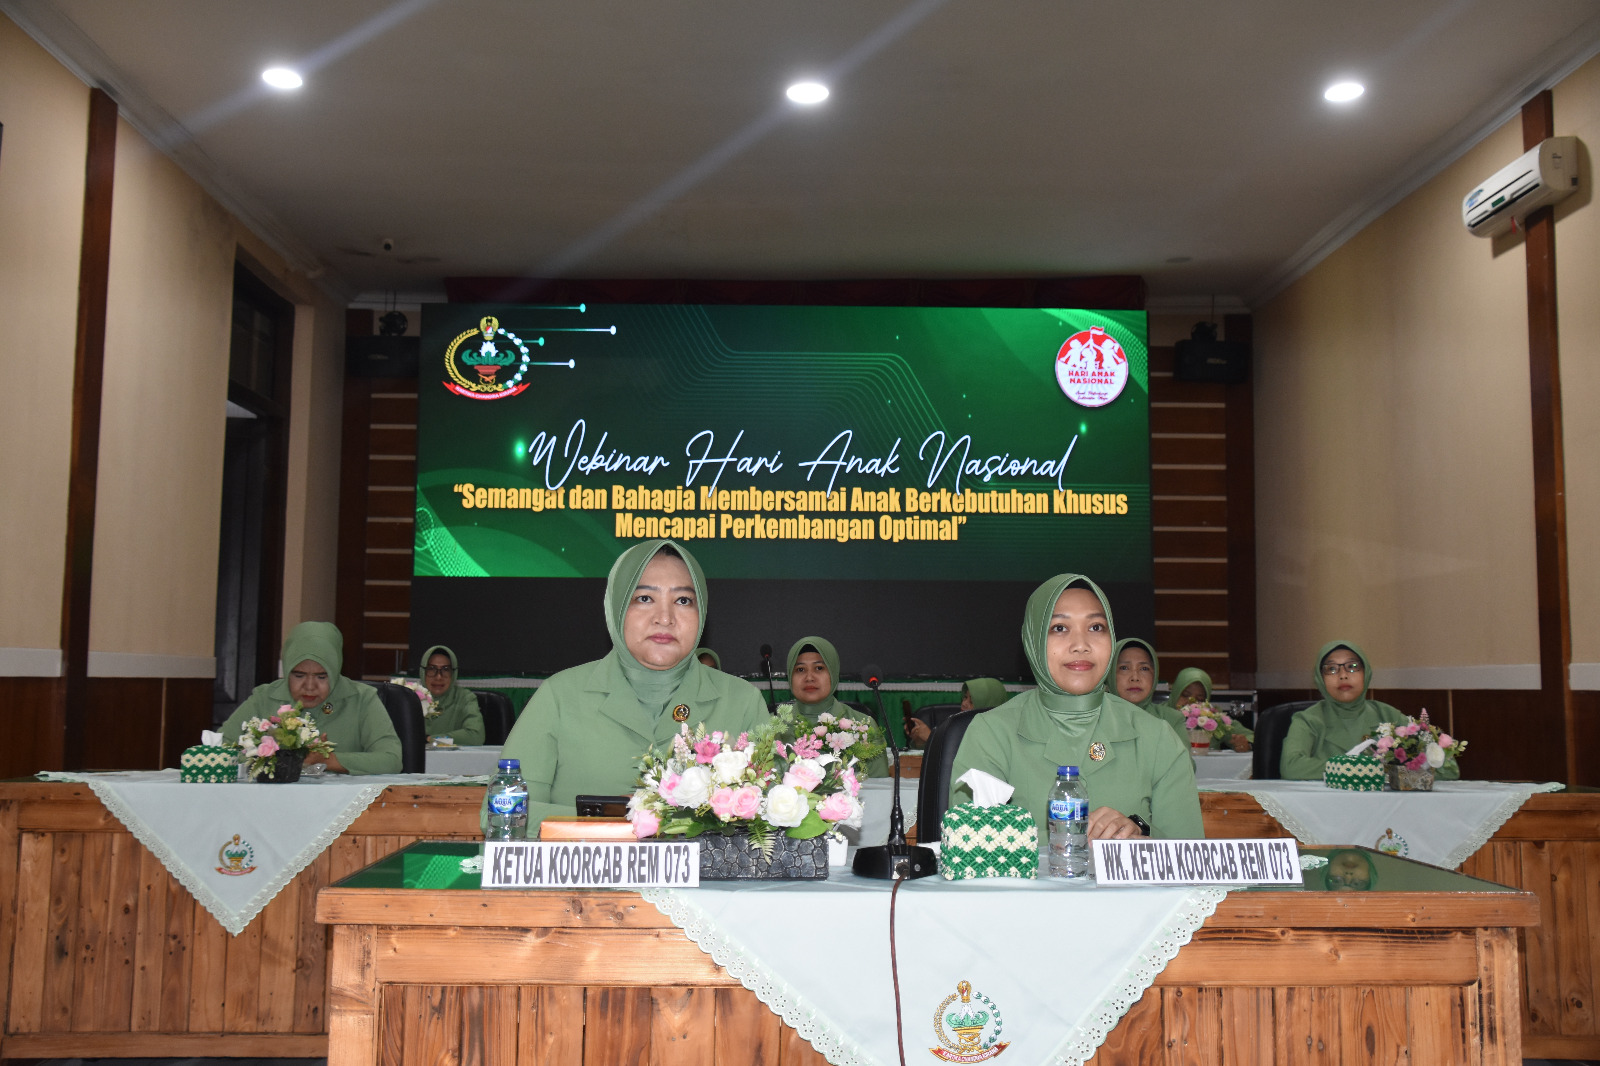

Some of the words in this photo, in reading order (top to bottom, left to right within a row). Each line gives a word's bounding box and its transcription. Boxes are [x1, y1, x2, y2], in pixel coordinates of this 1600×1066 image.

[528, 418, 670, 490] Webinar
[685, 429, 783, 498] Hari
[798, 429, 902, 498] Anak
[918, 431, 1078, 496] Nasional
[453, 483, 565, 512] “Semangat
[569, 485, 607, 510] dan
[611, 485, 696, 513] Bahagia
[700, 486, 847, 512] Membersamai
[850, 487, 901, 513] Anak
[905, 488, 1049, 514] Berkebutuhan
[1053, 489, 1128, 514] Khusus
[615, 513, 716, 541] Mencapai
[720, 514, 875, 542] Perkembangan
[879, 515, 967, 542] Optimal”
[494, 797, 512, 806] AQUA
[1051, 803, 1068, 812] AQUA
[491, 846, 543, 884] KETUA
[548, 845, 622, 884] KOORCAB
[627, 845, 659, 883] REM
[664, 845, 690, 883] 073
[1101, 843, 1129, 880] WK.
[1129, 843, 1175, 880] KETUA
[1174, 842, 1238, 880] KOORCAB
[1238, 842, 1269, 880] REM
[1268, 842, 1293, 880] 073
